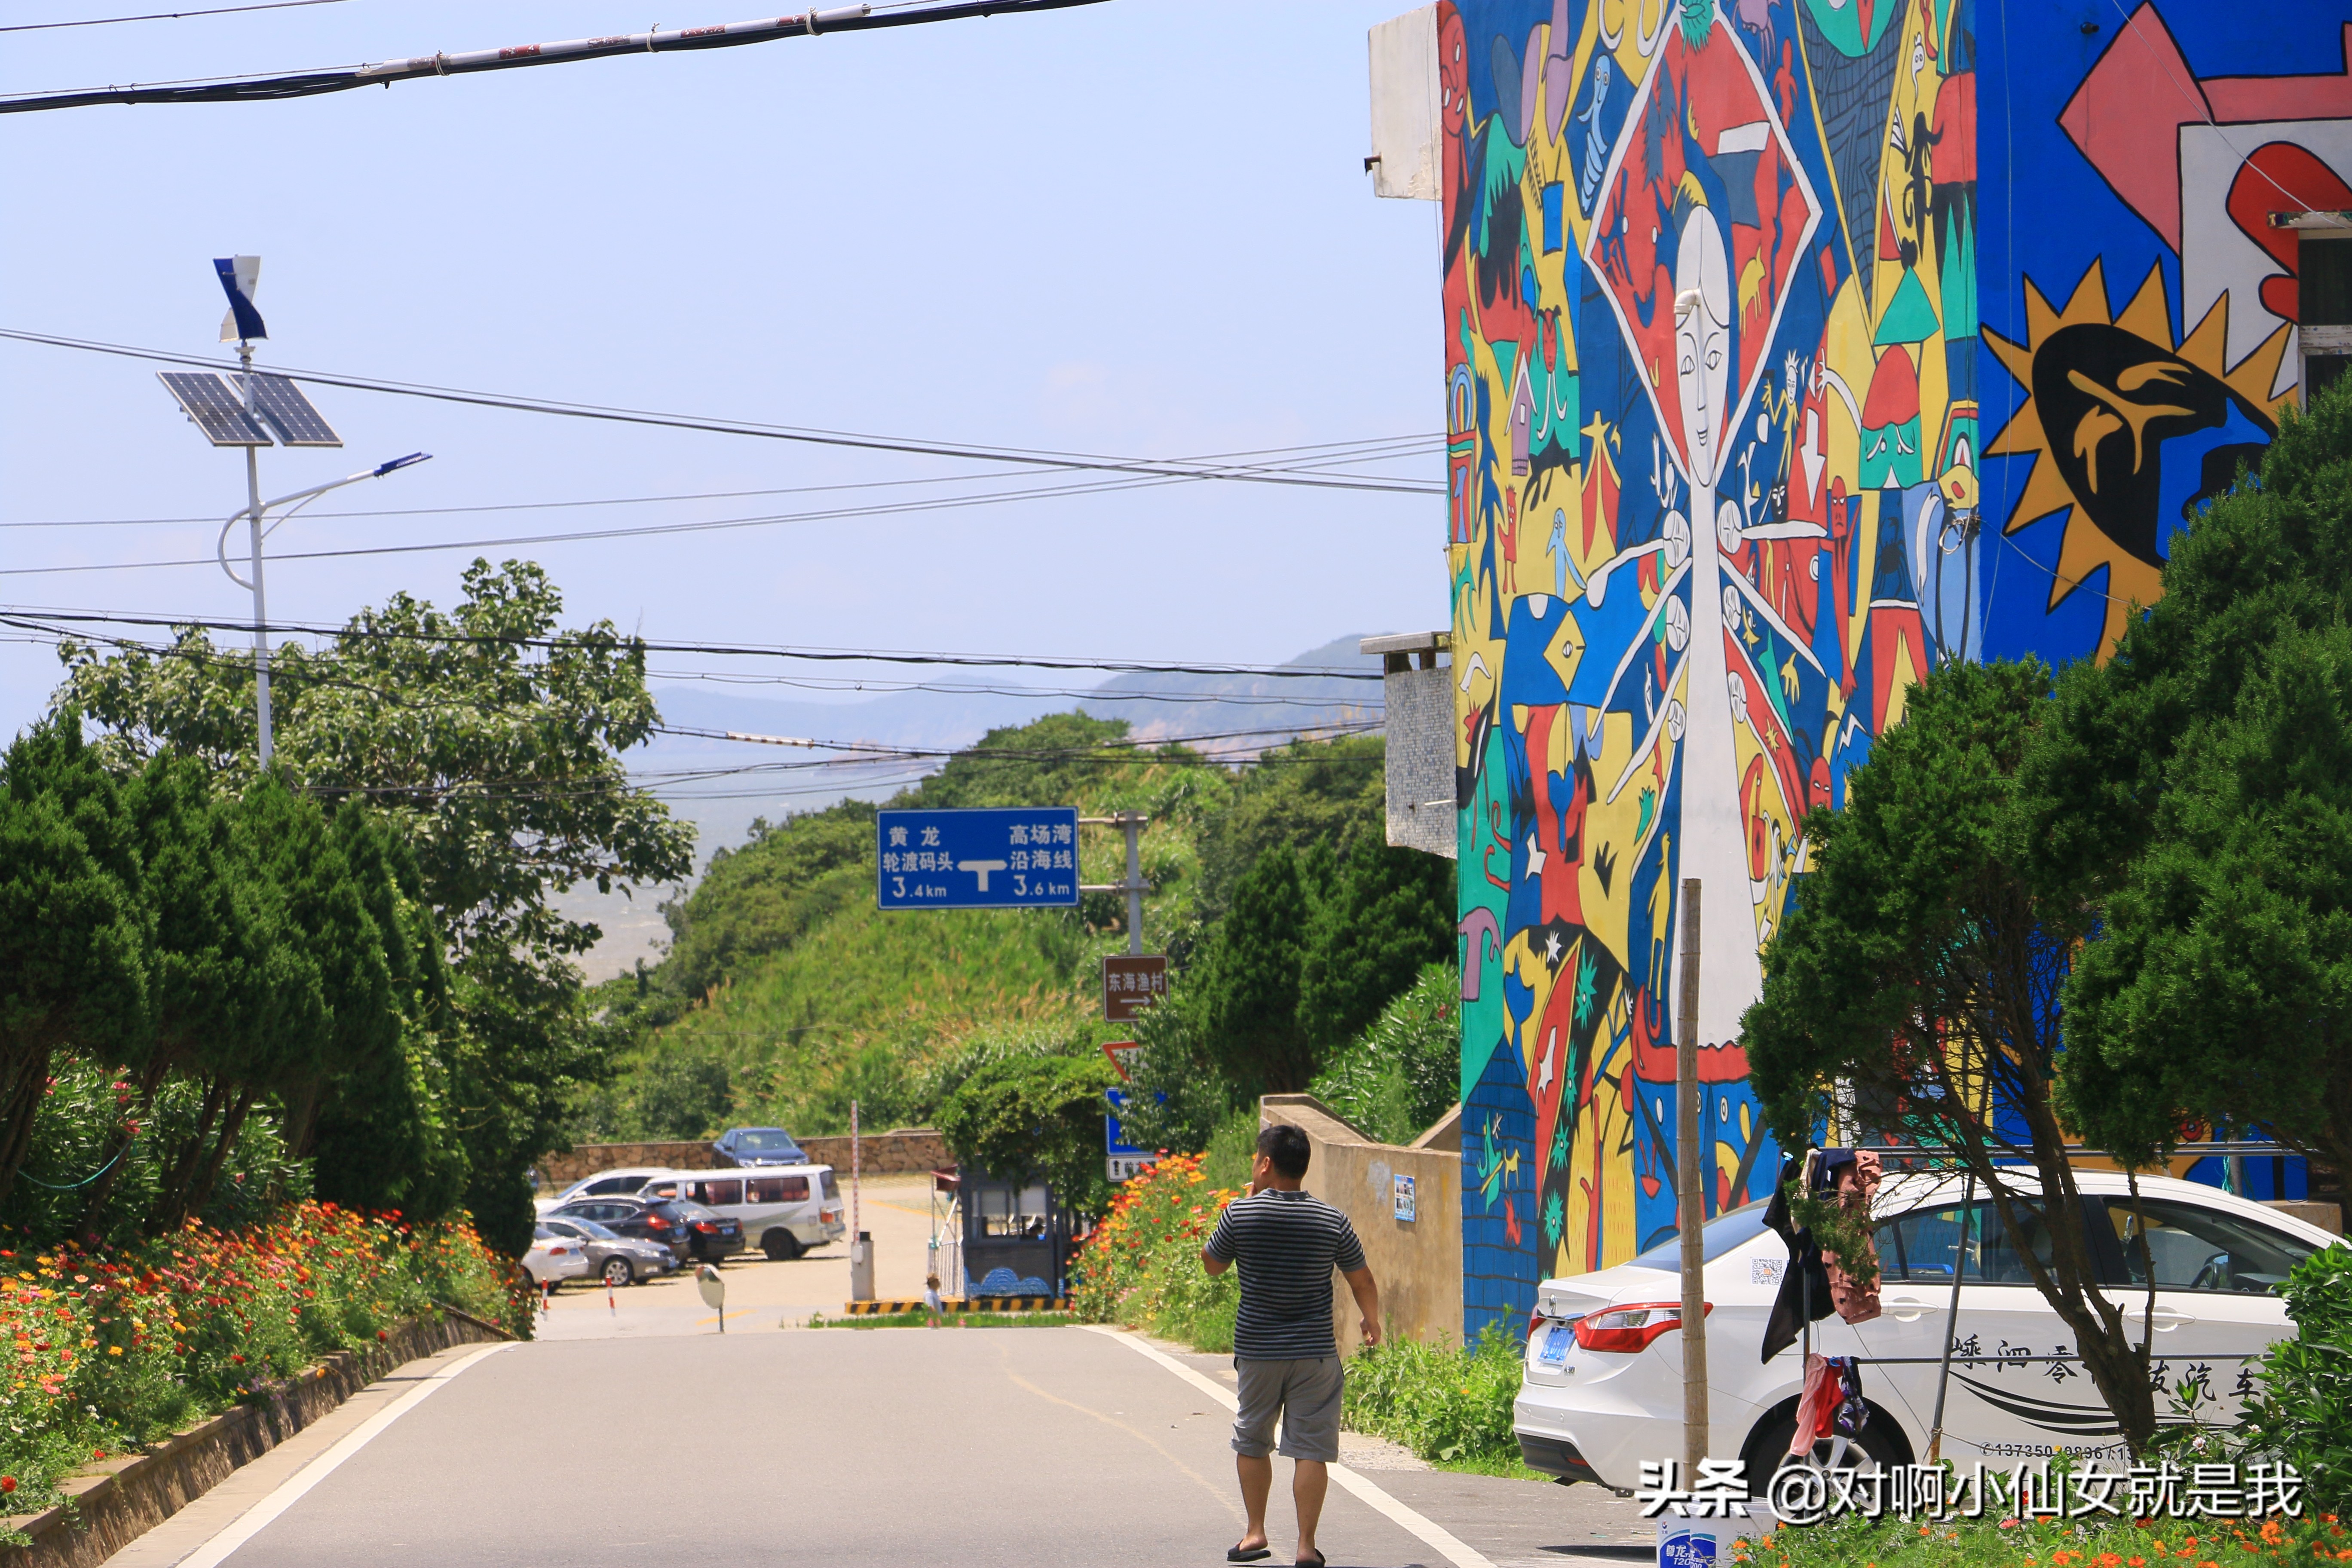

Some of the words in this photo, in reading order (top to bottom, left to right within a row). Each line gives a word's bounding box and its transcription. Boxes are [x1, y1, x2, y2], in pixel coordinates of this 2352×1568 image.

[888, 826, 940, 847] 黄龙
[1009, 824, 1072, 845] 高场湾
[882, 851, 954, 873] 轮渡码头
[1010, 849, 1073, 871] 沿海线
[1108, 971, 1164, 992] 东海渔村
